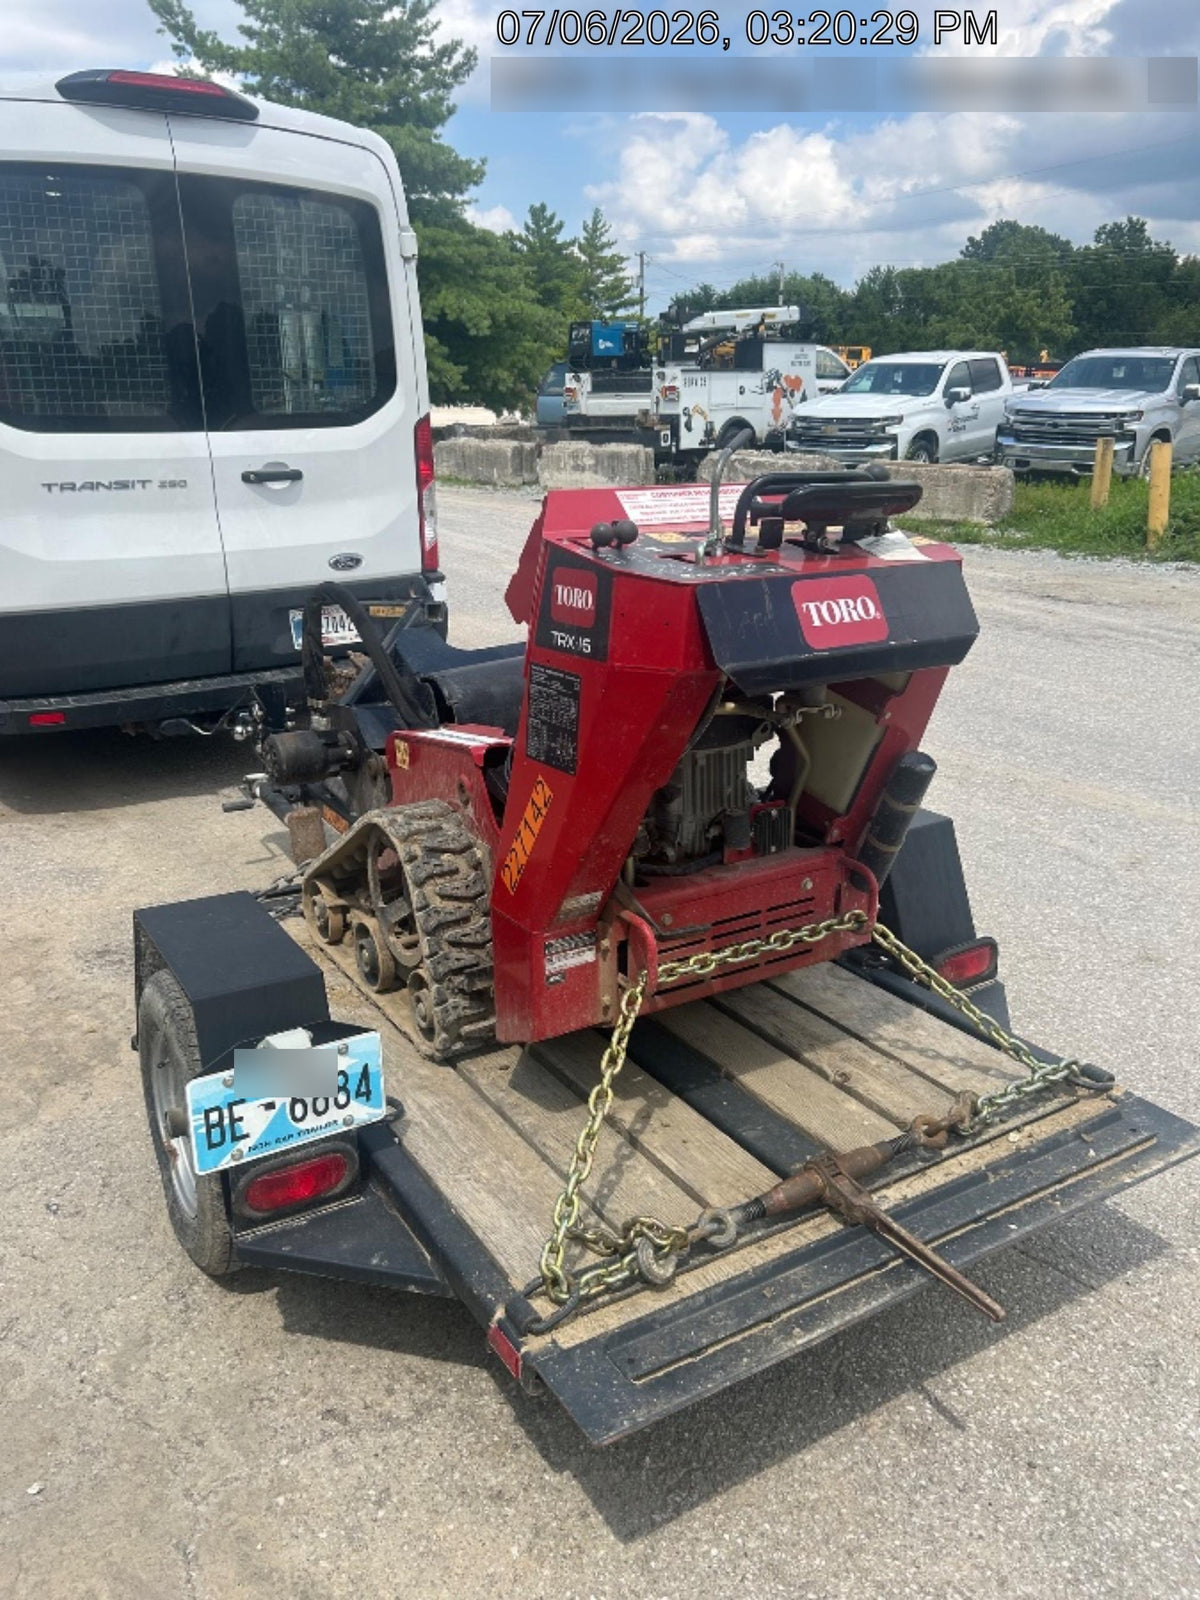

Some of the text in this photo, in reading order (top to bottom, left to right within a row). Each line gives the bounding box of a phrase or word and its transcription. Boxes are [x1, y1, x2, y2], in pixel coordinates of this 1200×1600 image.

[41, 479, 152, 494] TRANSIT
[554, 584, 593, 610] TORO
[801, 595, 876, 626] TORO
[501, 778, 553, 893] 227142
[203, 1098, 250, 1150] BE
